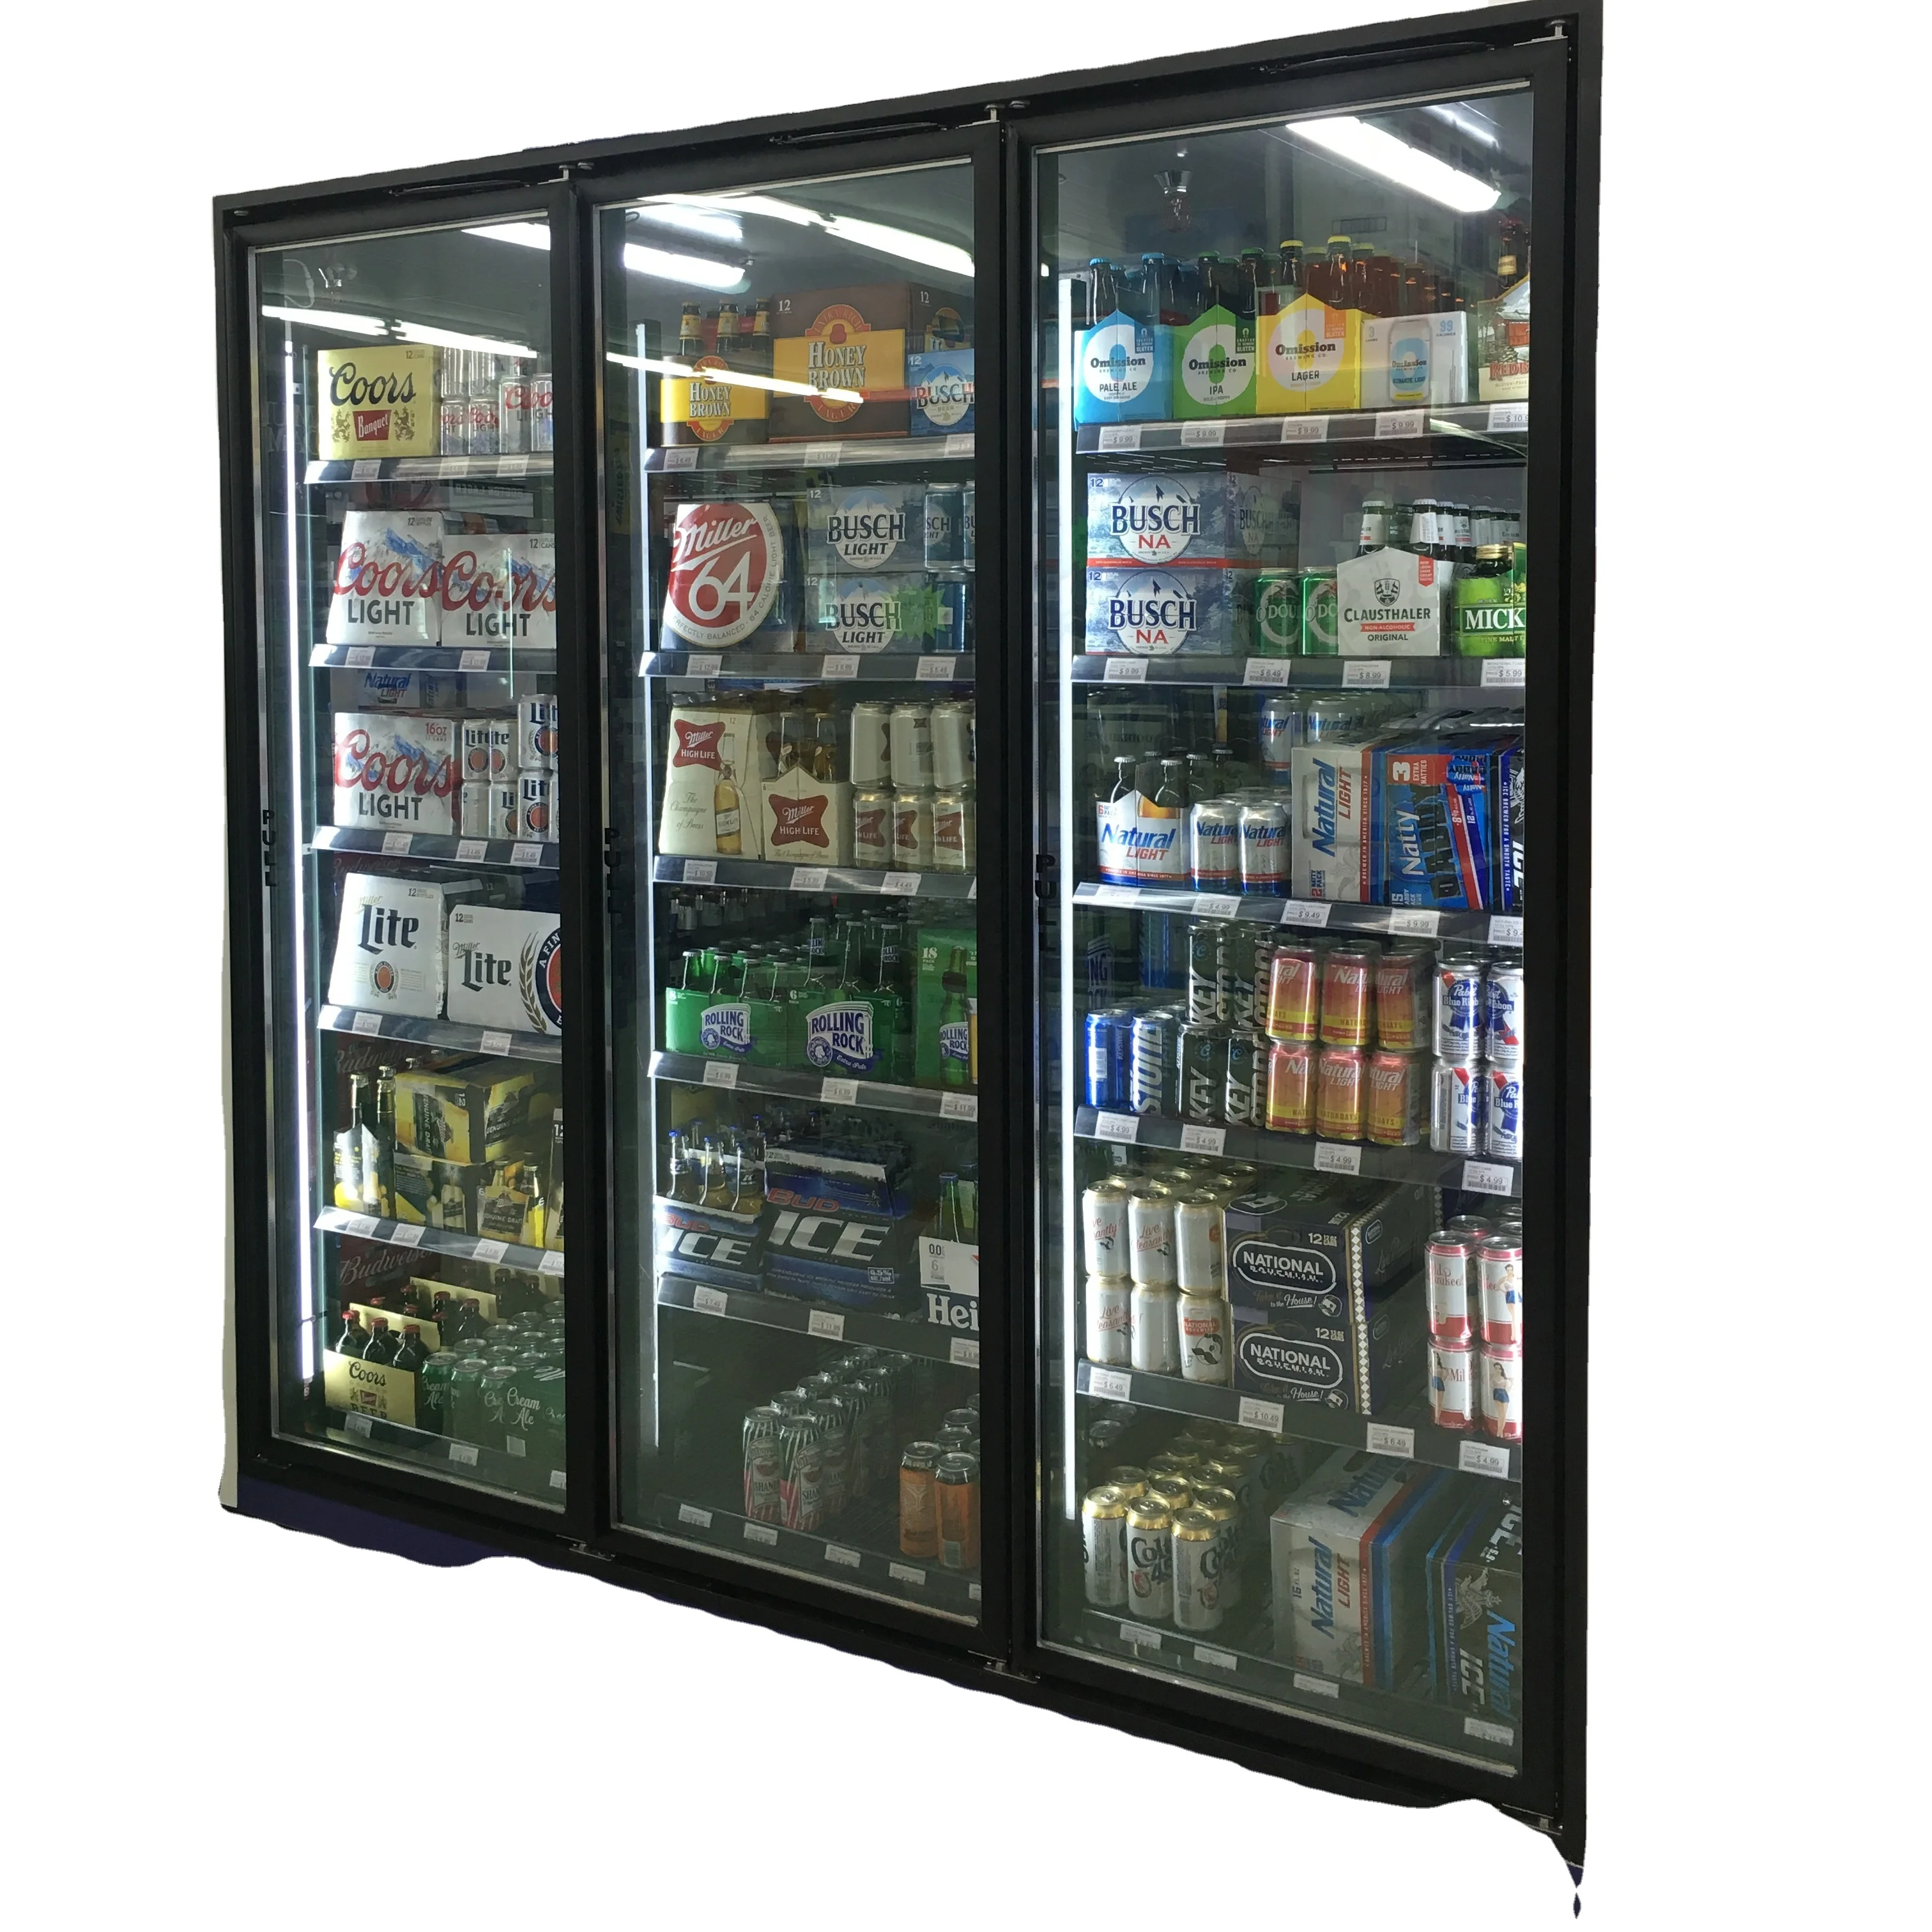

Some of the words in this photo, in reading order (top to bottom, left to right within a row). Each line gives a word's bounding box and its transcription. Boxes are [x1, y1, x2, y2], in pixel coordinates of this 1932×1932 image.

[920, 291, 930, 303] 12
[779, 300, 791, 312] 12
[1368, 326, 1374, 337] 3
[1440, 320, 1453, 332] 99
[808, 342, 866, 369] HONEY
[1275, 342, 1336, 356] Omission
[910, 356, 922, 365] 12
[1091, 357, 1146, 369] Omission
[1188, 358, 1246, 371] Omission
[808, 367, 866, 388] BROWN
[1292, 370, 1320, 381] LAGER
[329, 362, 417, 406] Coors
[1100, 383, 1119, 392] PALE
[1123, 382, 1137, 391] ALE
[1209, 385, 1223, 395] IPA
[689, 383, 731, 402] HONEY
[689, 401, 731, 418] BROWN
[358, 413, 388, 438] Banquet
[1091, 479, 1103, 487] 12
[1229, 475, 1237, 484] 12
[809, 490, 822, 498] 12
[407, 518, 415, 526] 12
[763, 516, 776, 538] BEER
[1112, 504, 1199, 534] BUSCH
[828, 513, 905, 543] BUSCH
[530, 539, 538, 548] 12
[672, 518, 758, 564] Miller
[844, 543, 888, 555] LIGHT
[1138, 535, 1171, 549] NA
[334, 542, 441, 598] Coors
[1089, 572, 1101, 581] 12
[1225, 571, 1233, 579] 12
[441, 551, 556, 611] Coors
[689, 551, 755, 620] 64
[807, 578, 818, 586] 12
[758, 571, 776, 609] CALORIE
[348, 599, 415, 625] LIGHT
[825, 602, 901, 631] BUSCH
[1108, 599, 1197, 630] BUSCH
[1344, 608, 1430, 623] CLAUSTHALER
[465, 613, 531, 636] LIGHT
[707, 623, 745, 640] BALANCED
[842, 632, 885, 643] LIGHT
[1136, 629, 1169, 644] NA
[1367, 633, 1409, 641] ORIGINAL
[365, 672, 411, 689] Natural
[381, 689, 407, 698] LIGHT
[685, 731, 714, 747] Miller
[681, 749, 699, 758] HIGH
[700, 750, 716, 759] LIFE
[335, 729, 461, 797] Coors
[1393, 761, 1410, 781] 3
[1338, 766, 1352, 820] LIGHT
[359, 792, 423, 820] LIGHT
[1098, 805, 1103, 815] 6
[1312, 758, 1335, 857] Natural
[782, 805, 815, 824] Miller
[780, 827, 801, 835] HIGH
[802, 827, 820, 836] LIFE
[1101, 822, 1176, 850] Natural
[1256, 838, 1285, 848] LIGHT
[1396, 809, 1425, 875] Natty
[1126, 846, 1169, 861] LIGHT
[408, 889, 416, 897] 12
[1392, 894, 1404, 905] 15
[455, 913, 463, 923] 12
[358, 904, 419, 954] Lite
[452, 942, 480, 959] Miller
[922, 947, 938, 960] 18
[461, 951, 511, 992] Lite
[790, 990, 797, 1000] 6
[1190, 967, 1216, 1025] KEY
[1453, 984, 1477, 997] Pabst
[1443, 997, 1460, 1006] Blue
[705, 1011, 744, 1027] ROLLING
[811, 1012, 864, 1035] ROLLING
[721, 1025, 744, 1042] ROCK
[832, 1032, 864, 1055] ROCK
[950, 1040, 967, 1050] ROCK
[1189, 1066, 1215, 1120] KEY
[1495, 1096, 1513, 1108] Blue
[767, 1188, 839, 1213] BUD
[664, 1213, 711, 1232] BUD
[767, 1209, 891, 1262] ICE
[1140, 1224, 1160, 1239] Live
[1308, 1232, 1322, 1245] 12
[658, 1227, 752, 1265] ICE
[931, 1259, 939, 1271] 6
[1243, 1250, 1324, 1276] NATIONAL
[1284, 1294, 1317, 1308] House!
[1100, 1305, 1120, 1319] Live
[1315, 1327, 1330, 1340] 12
[1250, 1343, 1331, 1370] NATIONAL
[349, 1361, 387, 1386] Coors
[507, 1387, 540, 1410] Cream
[1290, 1387, 1324, 1401] House!
[510, 1407, 534, 1431] Ale
[1308, 1535, 1335, 1639] Natural
[1337, 1552, 1351, 1609] LIGHT
[1292, 1586, 1303, 1599] 16
[1487, 1609, 1519, 1722] Natural
[1460, 1648, 1485, 1705] ICE
